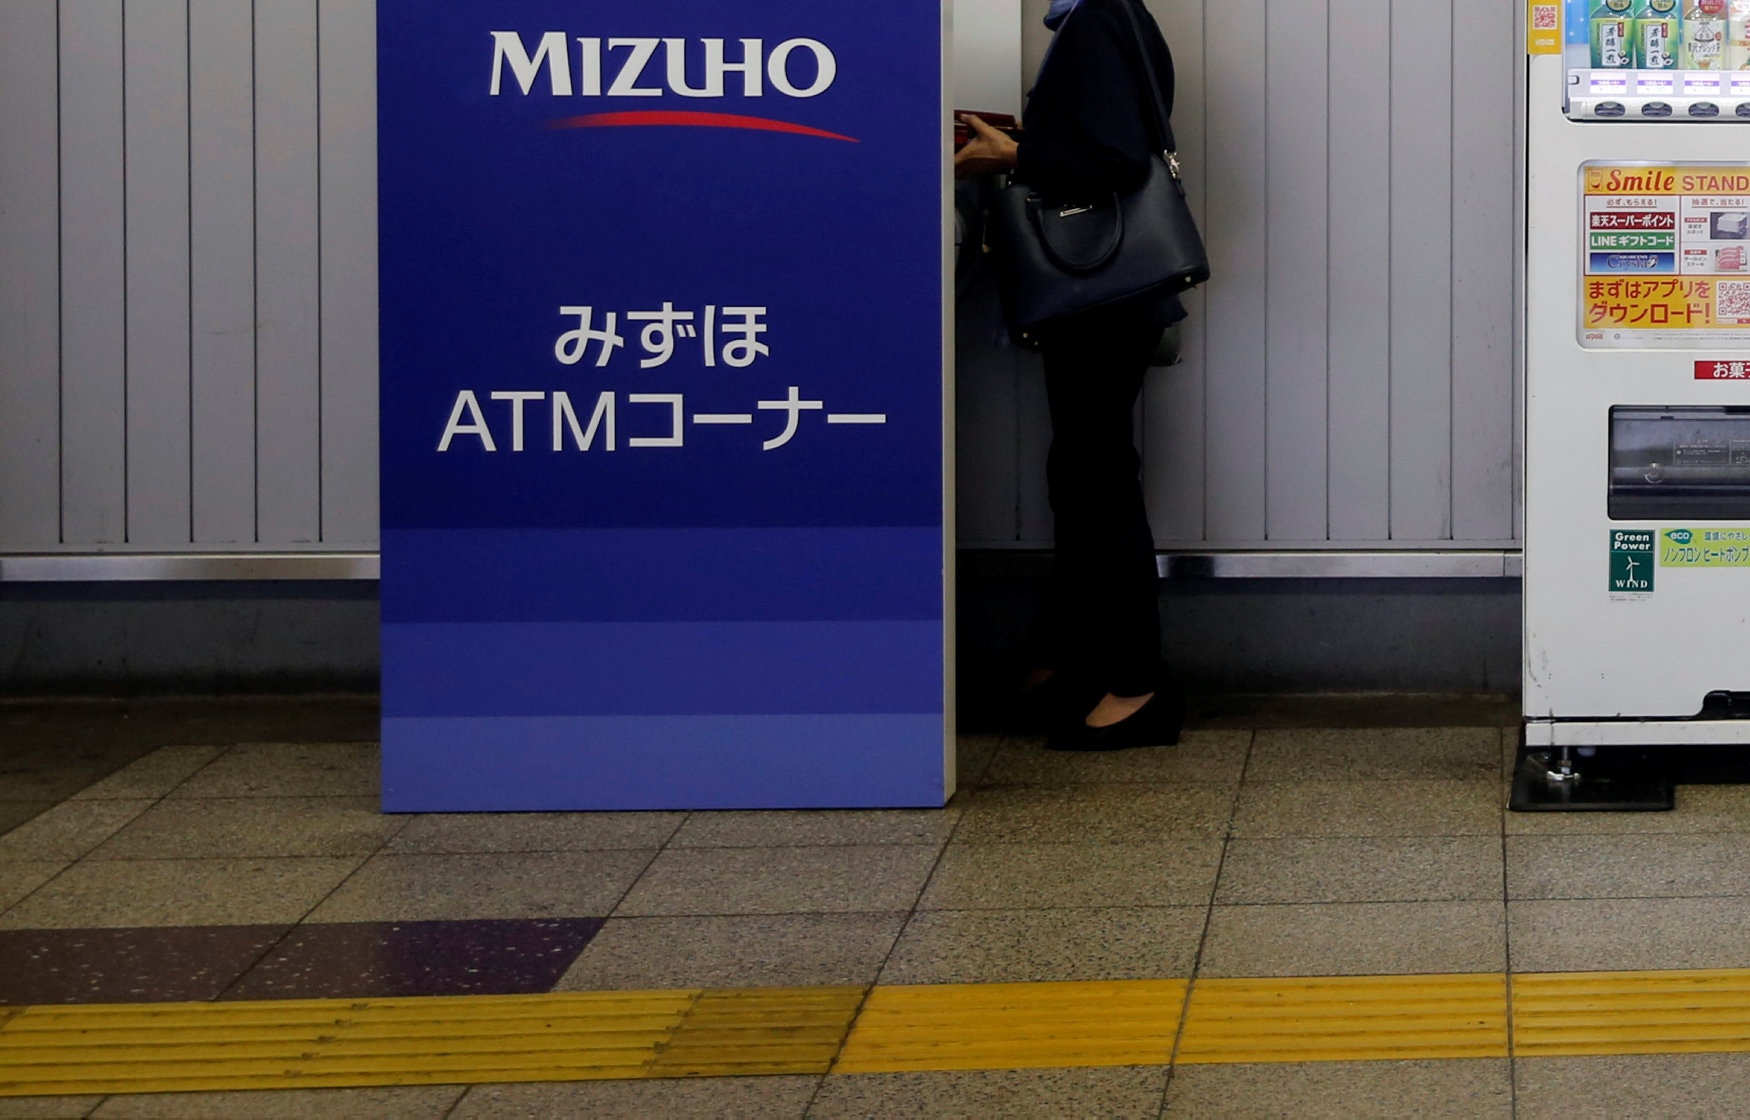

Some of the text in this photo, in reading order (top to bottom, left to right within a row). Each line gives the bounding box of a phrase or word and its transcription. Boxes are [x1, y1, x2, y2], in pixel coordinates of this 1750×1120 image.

[490, 31, 837, 98] MIZUHO
[1606, 169, 1750, 192] Smile STAND
[1606, 197, 1657, 207] 必ず、もらえる!
[1692, 197, 1744, 207] 抽選で、当たる!
[1591, 214, 1675, 228] 楽天スーパーポイント
[1591, 234, 1675, 247] LINE ギフトコード
[1588, 278, 1710, 299] まずはアプリを
[1588, 301, 1711, 325] ダウンロード!
[555, 301, 769, 369] みずほ
[437, 386, 886, 452] ATMコーナー
[1615, 532, 1650, 543] Green
[1669, 531, 1691, 541] eco
[1614, 540, 1651, 551] Power
[1615, 579, 1649, 589] WIND
